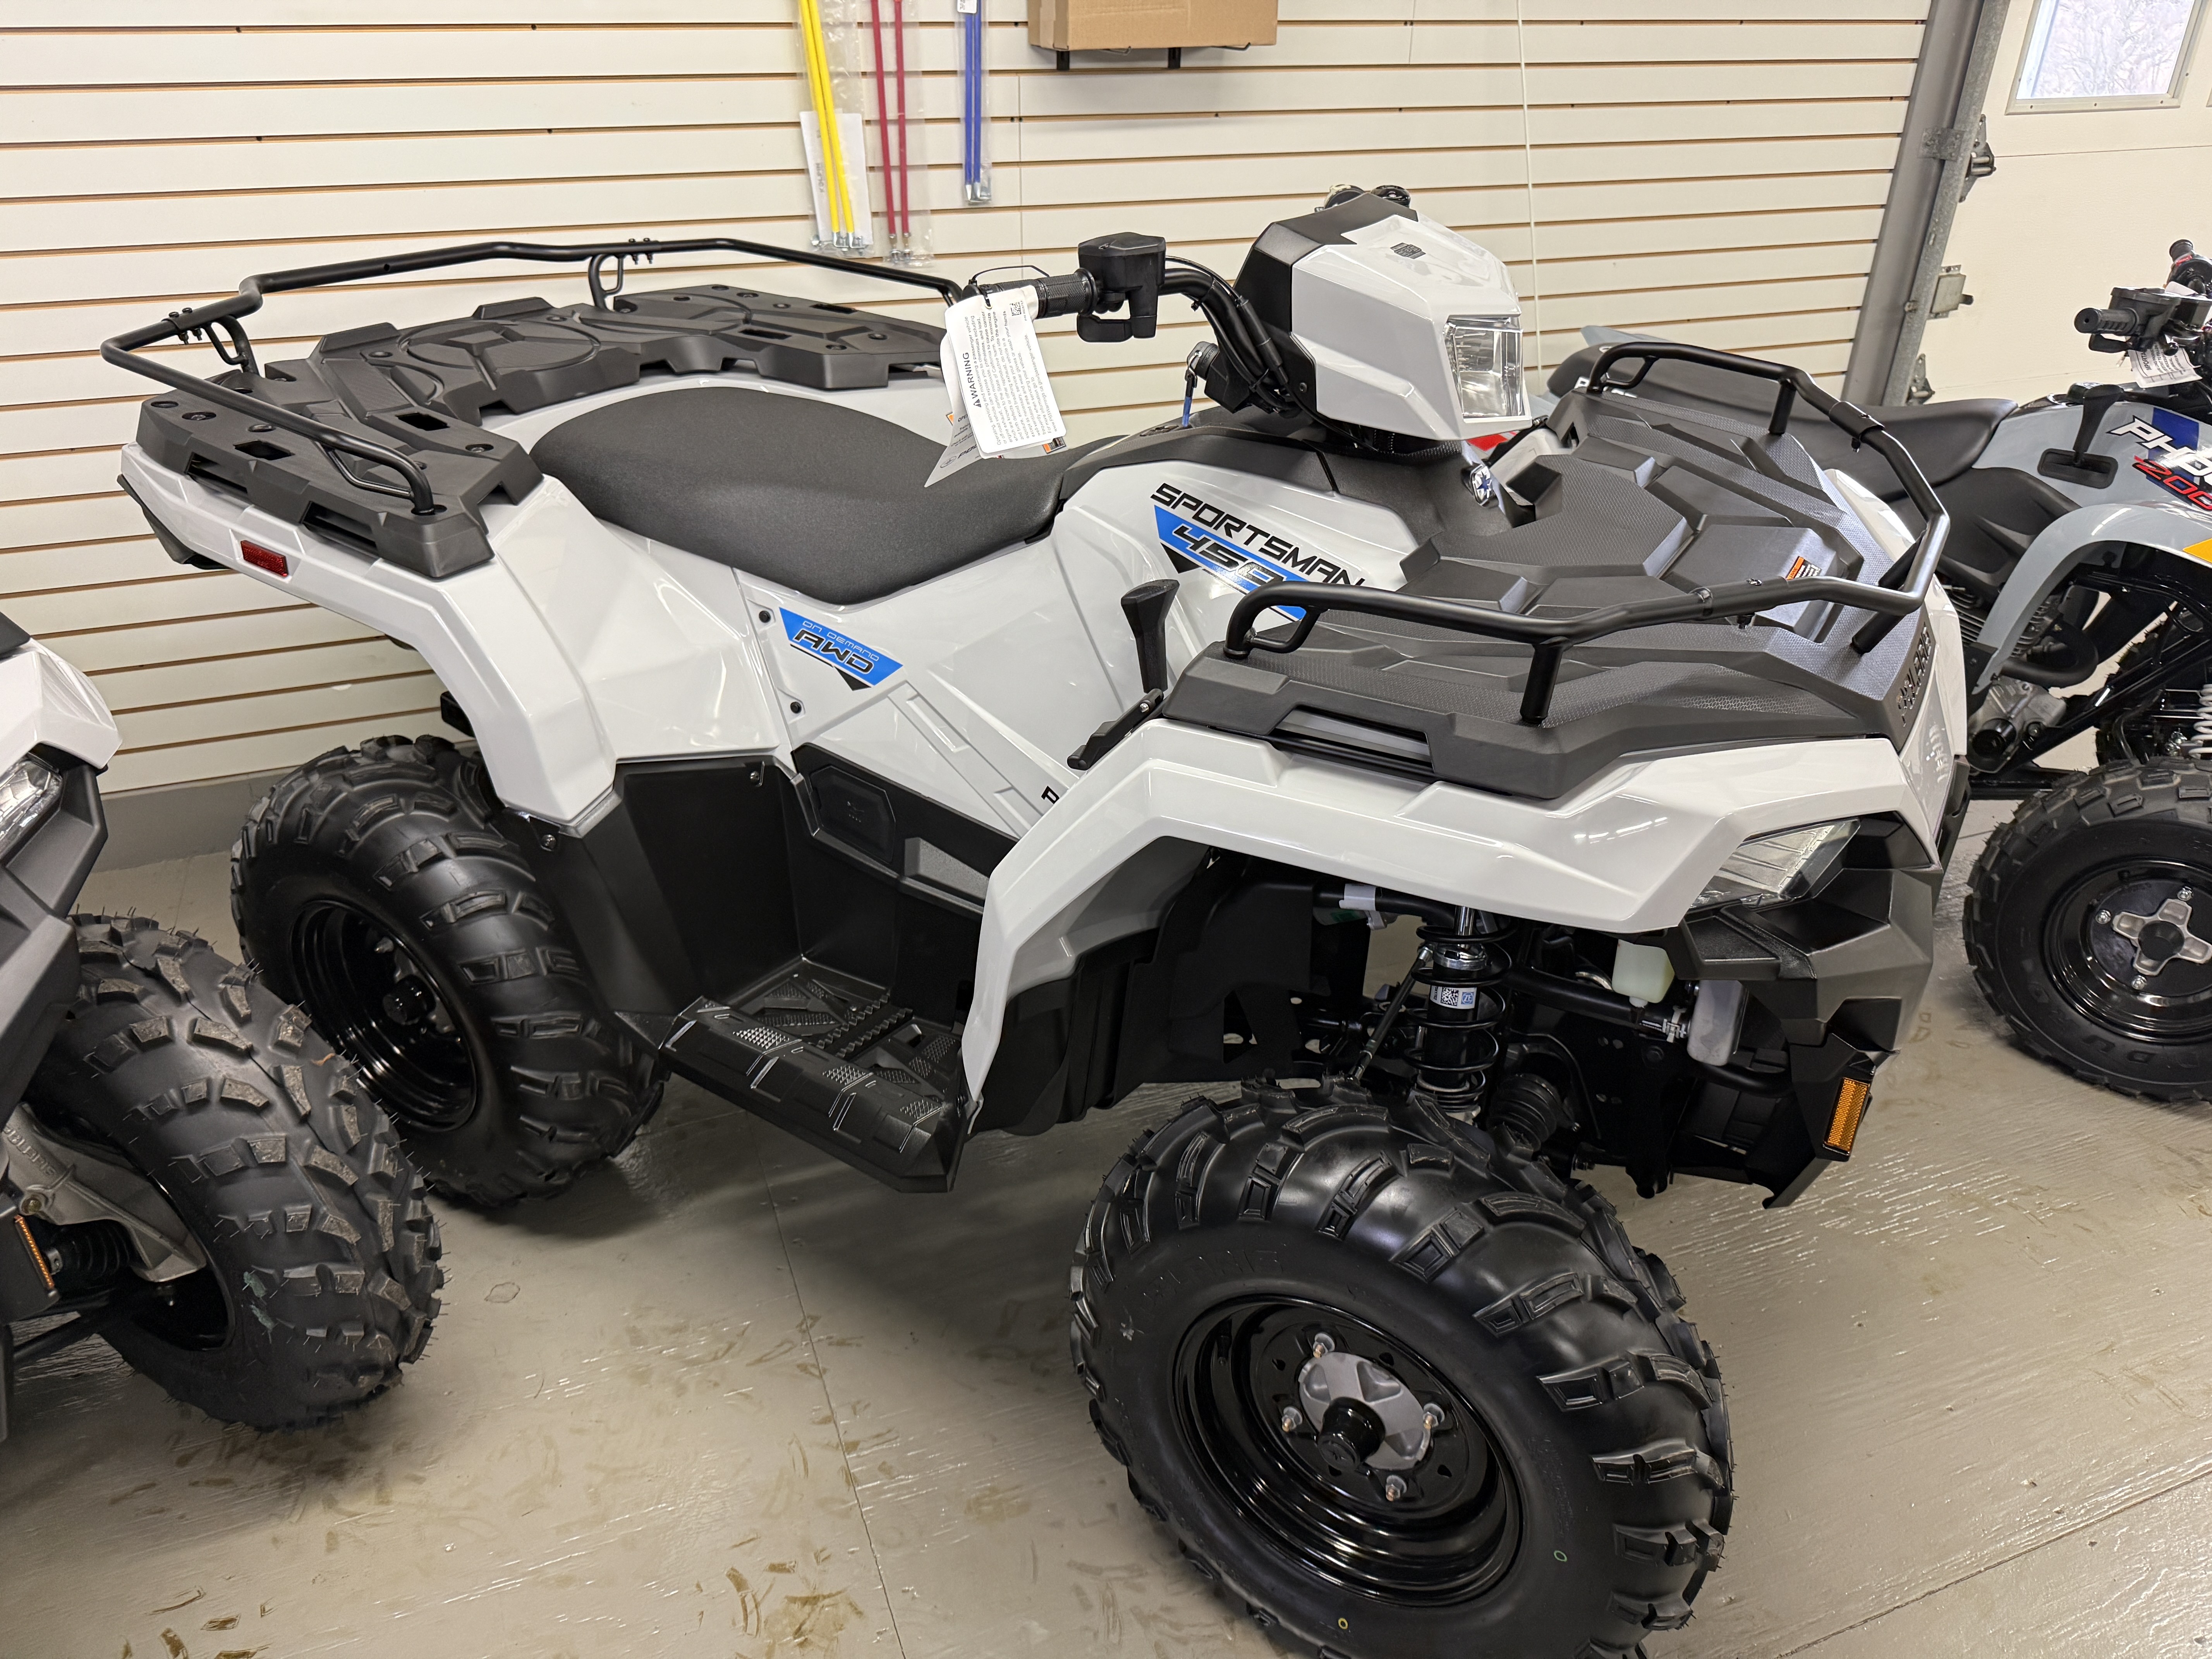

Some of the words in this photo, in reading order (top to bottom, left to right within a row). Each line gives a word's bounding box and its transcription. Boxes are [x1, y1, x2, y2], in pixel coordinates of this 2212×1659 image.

[968, 334, 976, 360] passenger
[1003, 347, 1012, 364] vehicle
[987, 350, 996, 373] California
[995, 357, 1006, 386] reproductive
[1013, 357, 1021, 373] gloves
[2140, 352, 2152, 371] IMPORTA
[962, 351, 979, 398] WARNING
[974, 365, 984, 392] maintaining
[983, 379, 991, 396] expose
[1008, 383, 1017, 405] breathing
[1025, 380, 1034, 400] servicing
[993, 393, 1001, 409] carbon
[1034, 389, 1045, 414] information
[984, 402, 993, 422] servicing
[991, 406, 999, 422] vehicle
[1008, 405, 1017, 421] defects
[1027, 423, 1035, 437] except
[1036, 414, 1046, 435] frequently
[1005, 428, 1013, 443] engine
[1150, 483, 1365, 586] SPORTSMAN
[793, 628, 874, 674] AWD
[802, 621, 822, 633] ON
[827, 632, 879, 661] DEMAND
